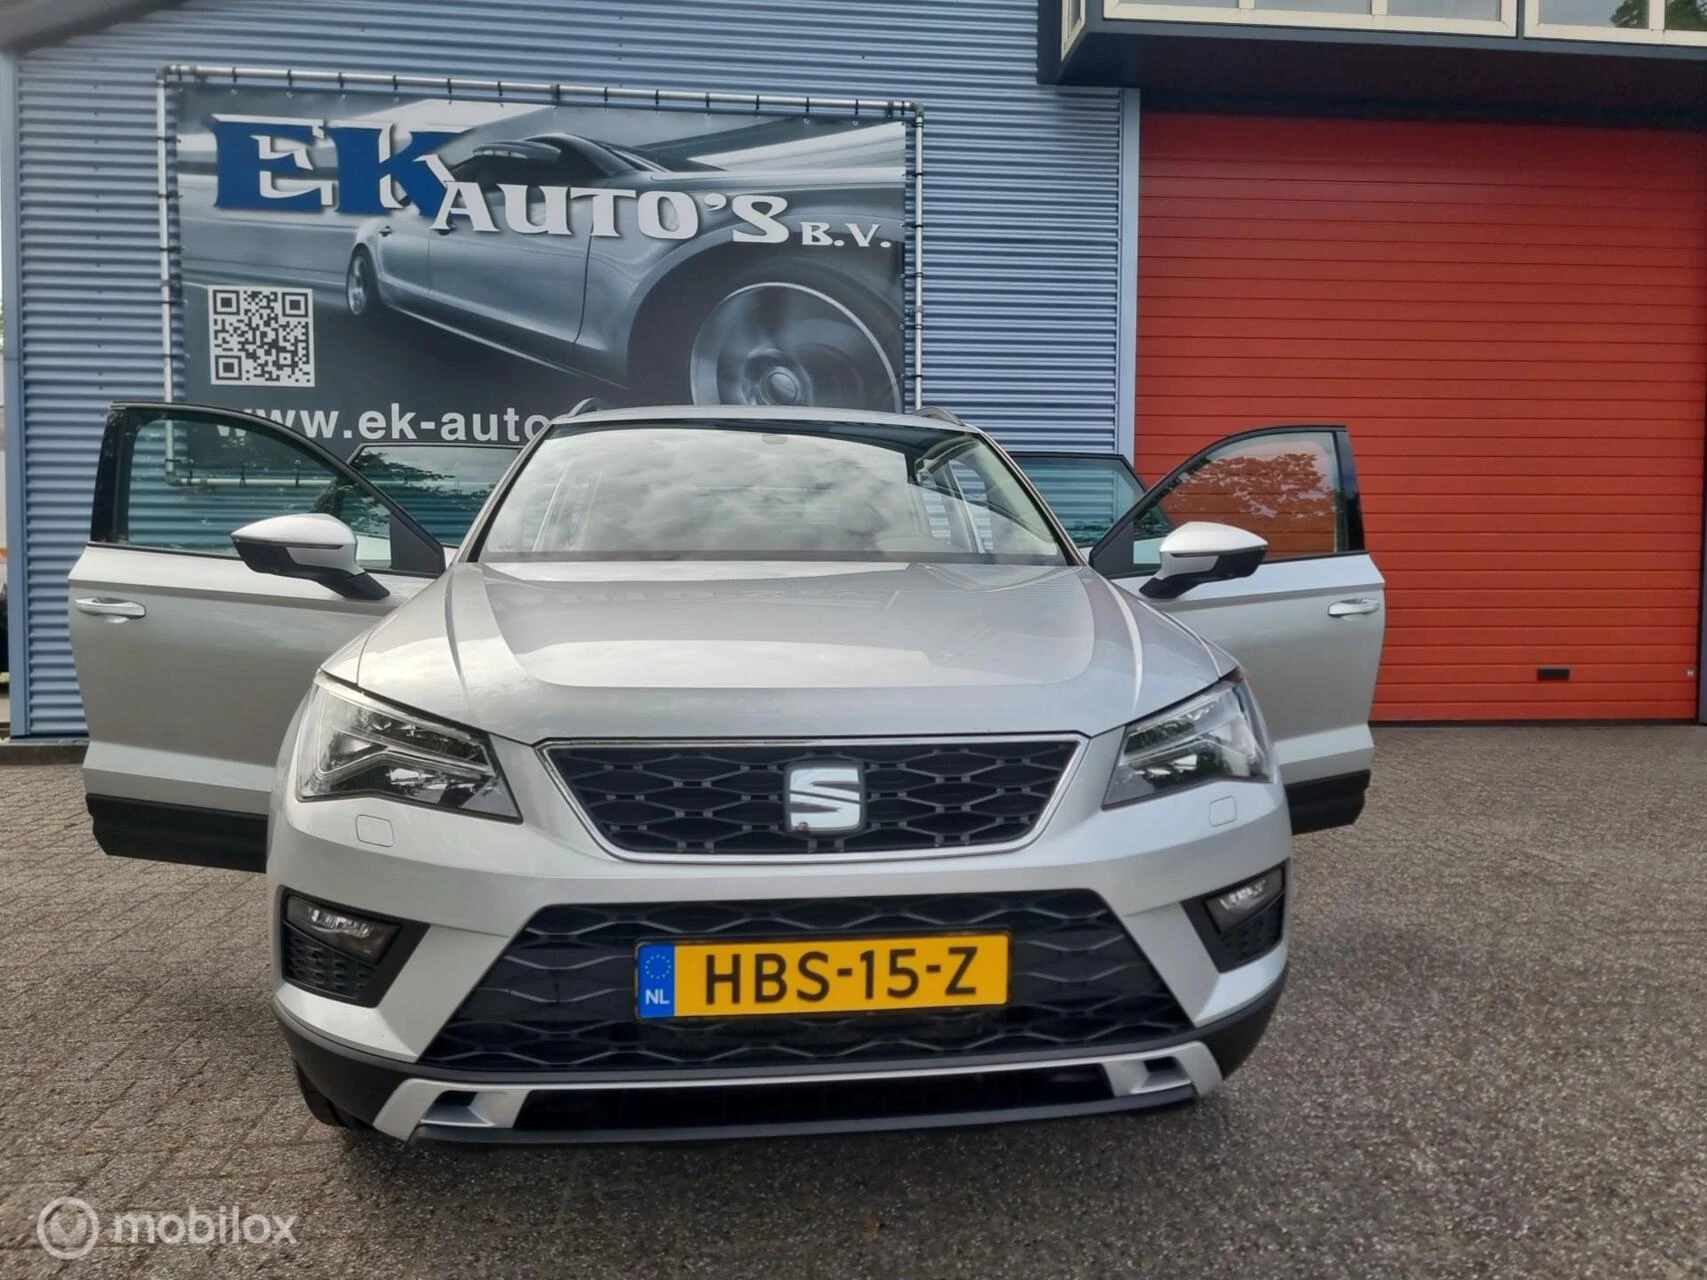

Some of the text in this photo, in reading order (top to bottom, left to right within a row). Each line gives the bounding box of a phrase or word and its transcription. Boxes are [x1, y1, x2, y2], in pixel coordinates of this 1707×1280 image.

[210, 113, 472, 217] EK
[800, 221, 892, 248] B.V.
[645, 945, 979, 1006] NL HBS-15-Z
